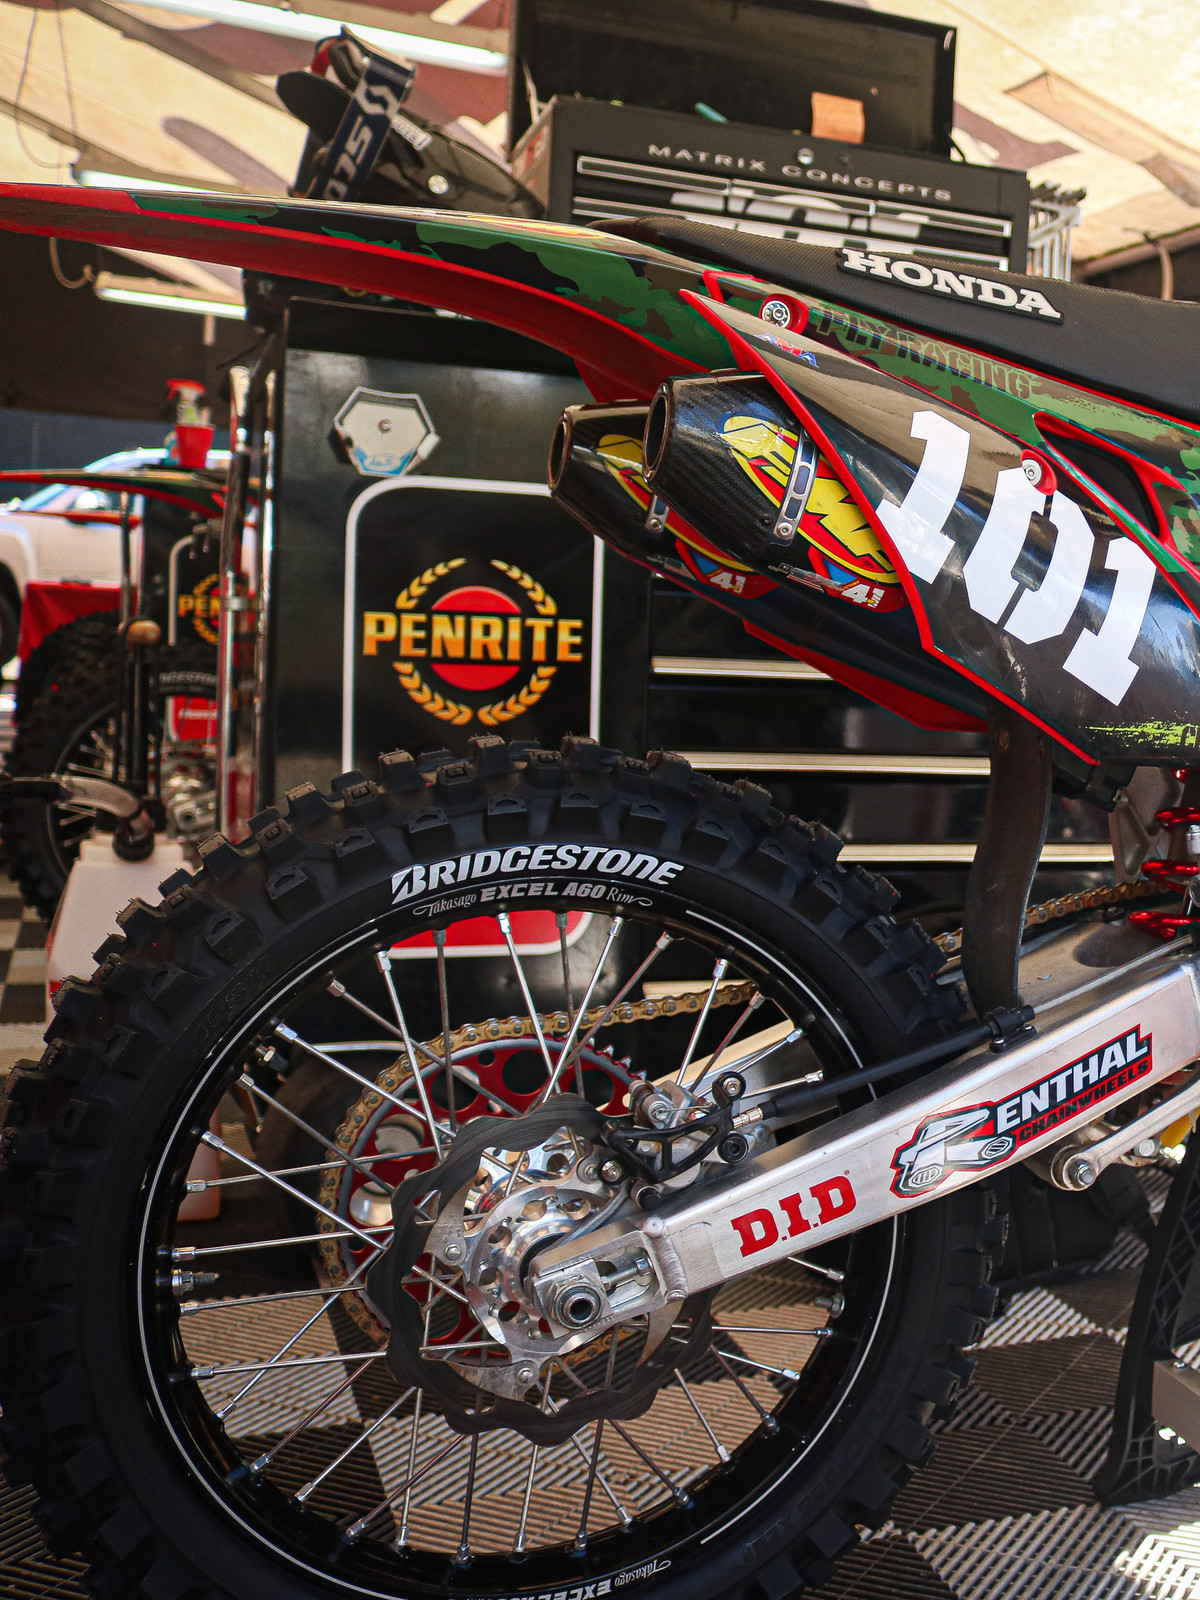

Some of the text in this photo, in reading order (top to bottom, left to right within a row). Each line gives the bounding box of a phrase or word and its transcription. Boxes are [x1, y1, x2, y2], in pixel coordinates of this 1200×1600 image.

[648, 144, 952, 201] MATRIX CONCEPTS
[841, 248, 1062, 318] HONDA
[897, 330, 1042, 401] RACING
[874, 410, 1158, 707] 101
[362, 611, 584, 662] PENRITE
[391, 844, 685, 905] BRIDGESTONE
[413, 892, 478, 918] Takasago
[480, 881, 558, 903] EXCEL
[561, 881, 607, 899] A60
[1018, 1059, 1149, 1142] CHAINWHEELS
